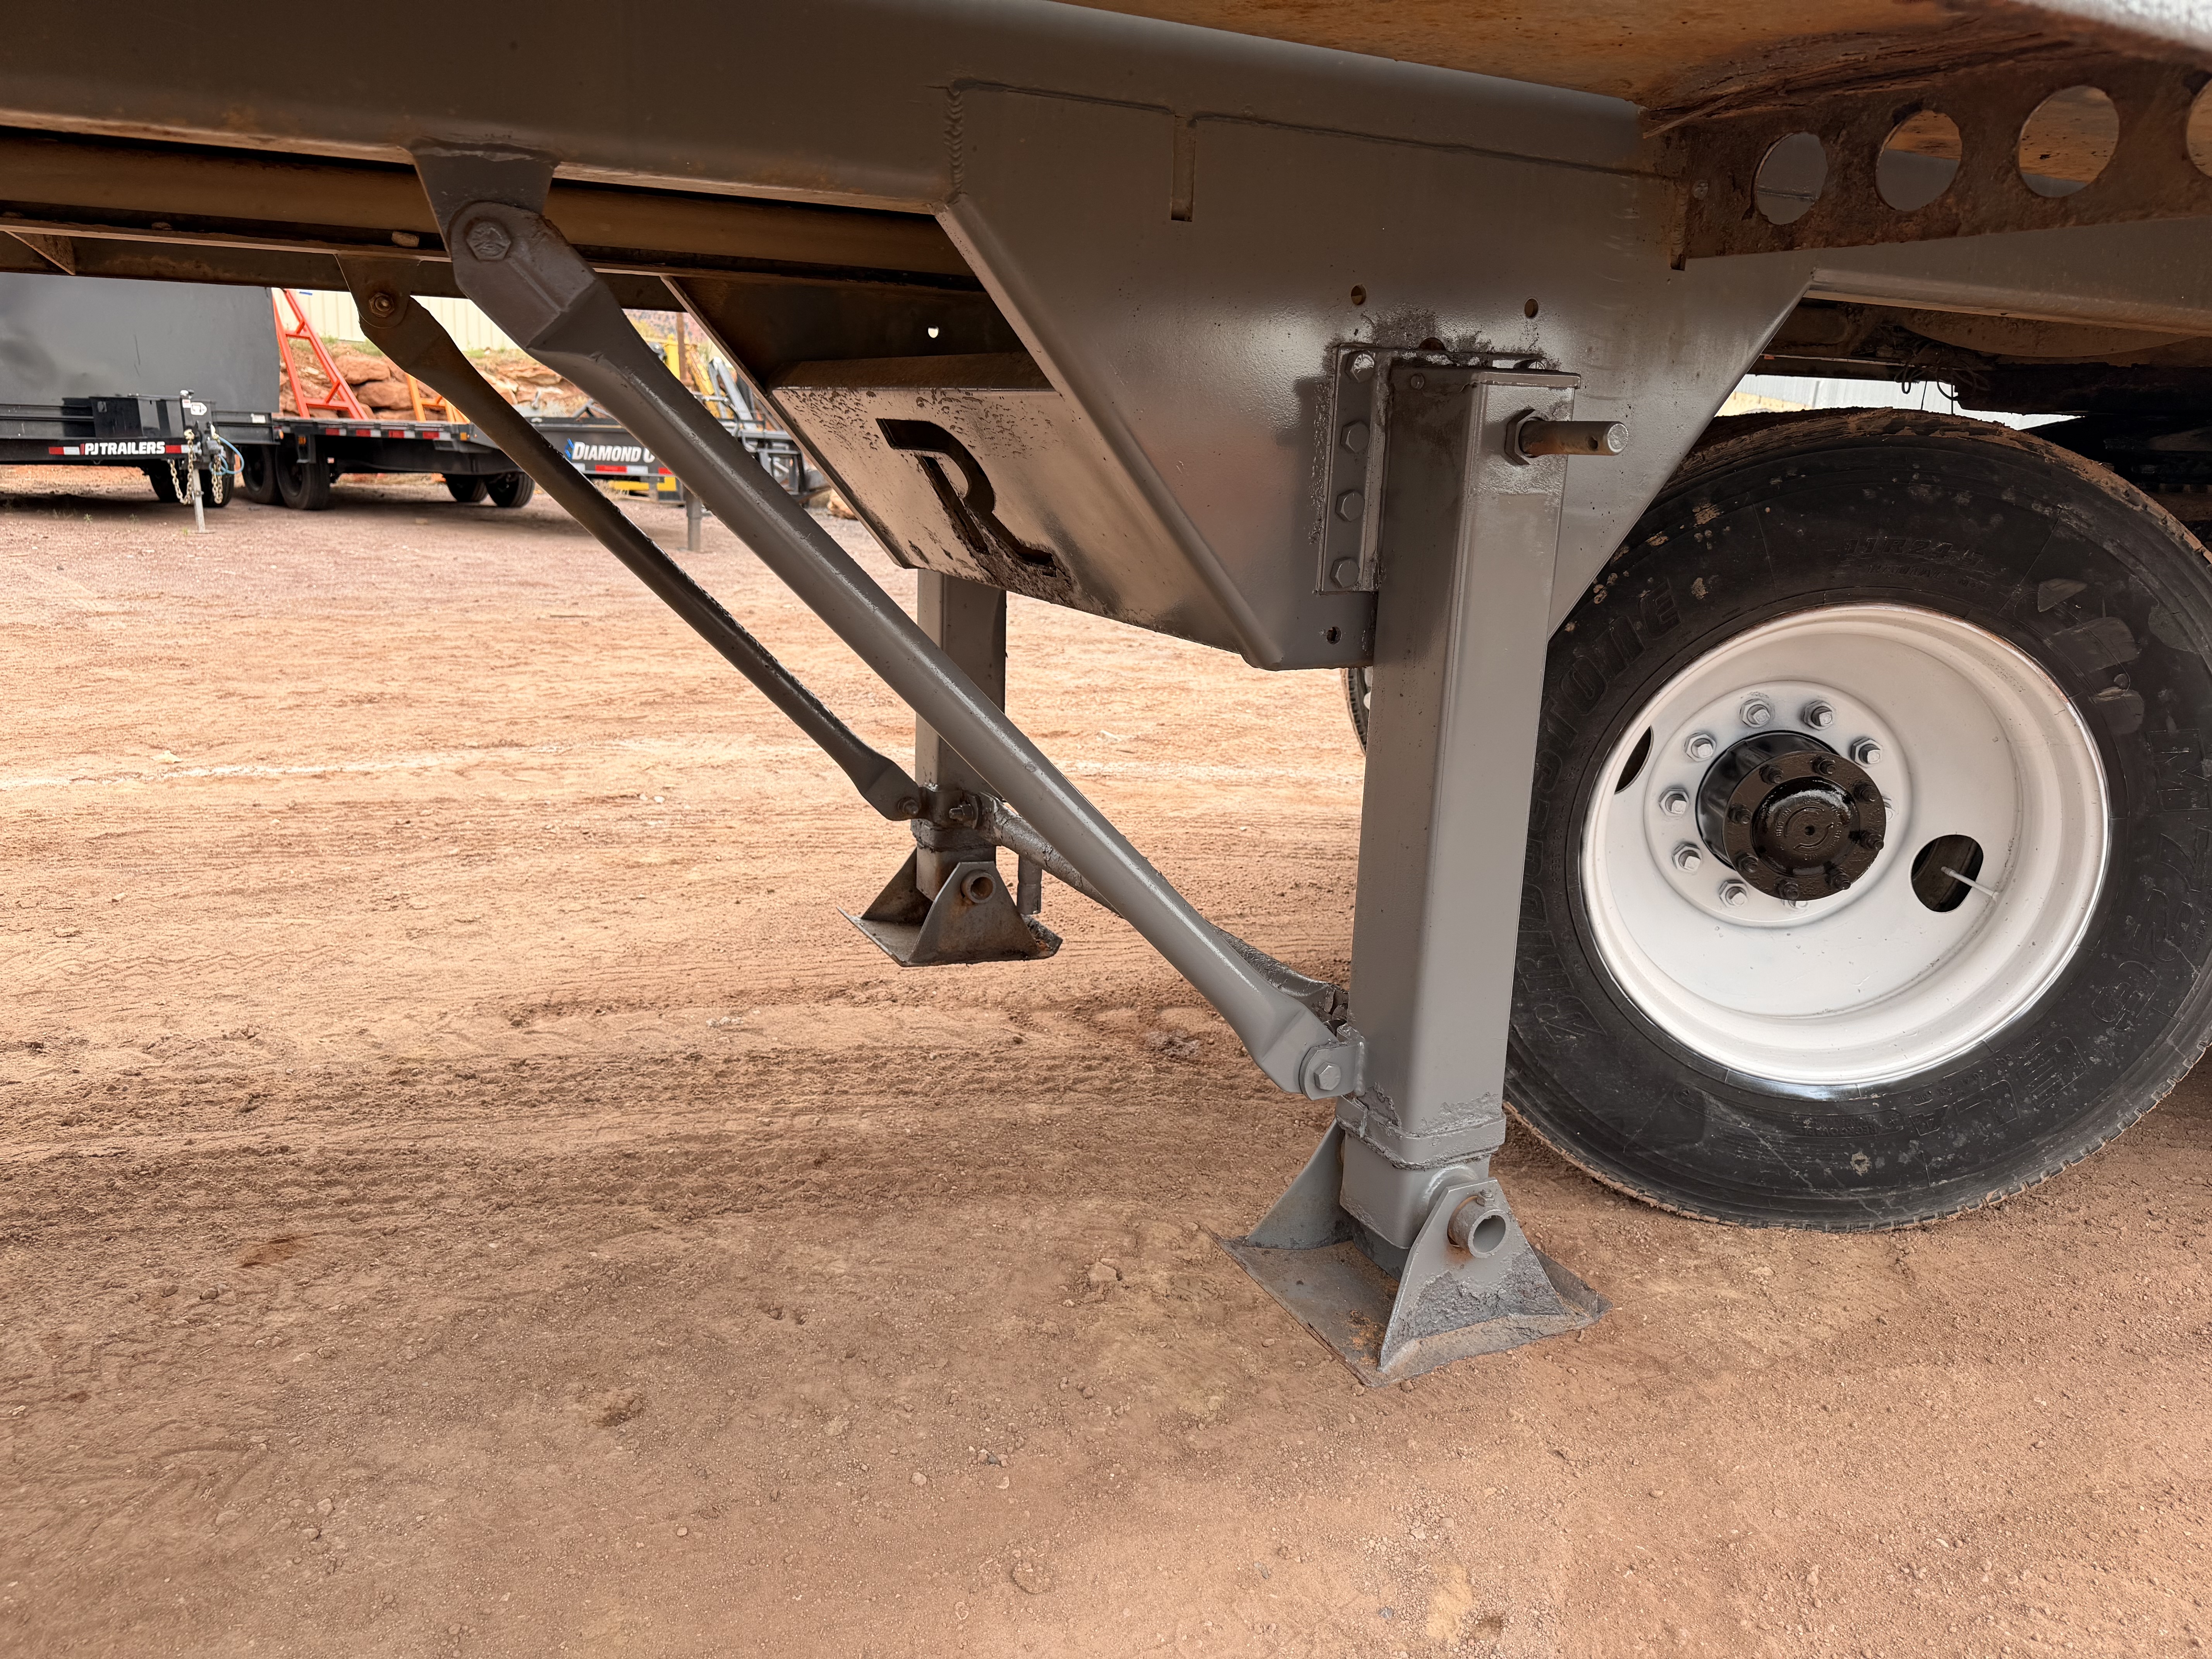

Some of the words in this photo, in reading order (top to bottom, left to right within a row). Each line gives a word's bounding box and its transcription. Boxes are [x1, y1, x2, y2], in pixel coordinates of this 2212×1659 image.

[85, 443, 98, 455] PJ
[100, 441, 165, 455] TRAILERS
[572, 441, 641, 462] DIAMOND
